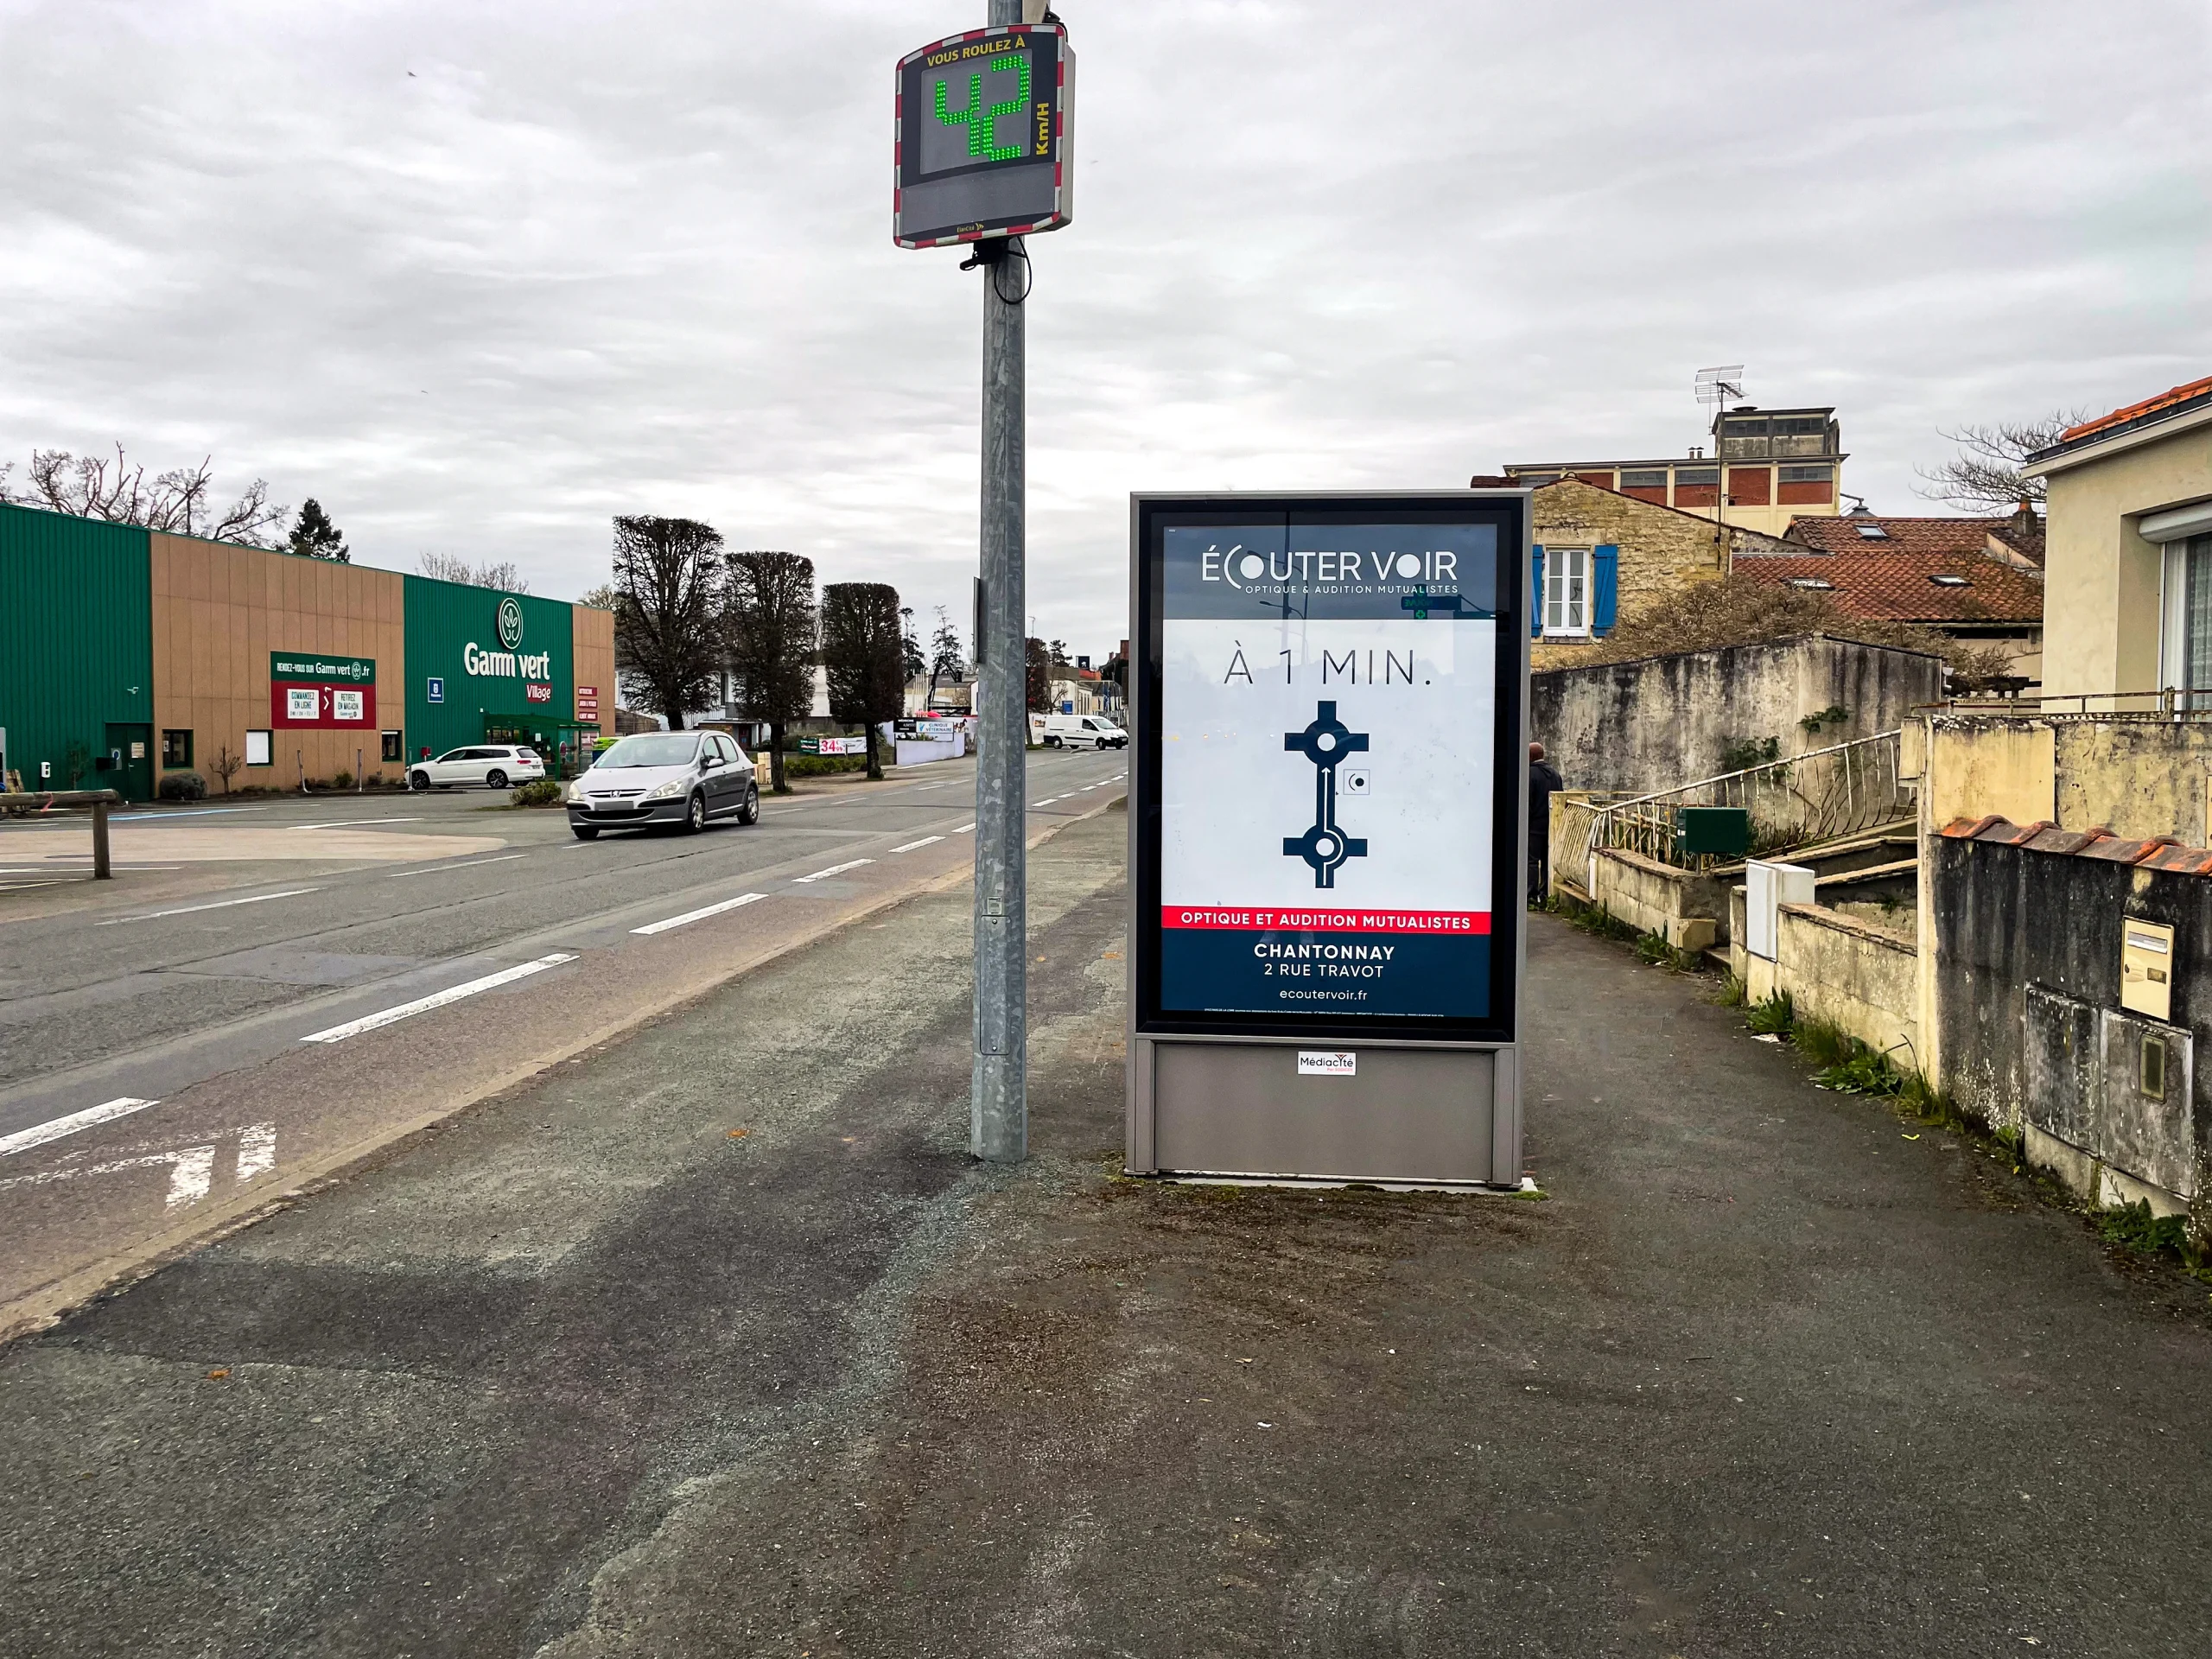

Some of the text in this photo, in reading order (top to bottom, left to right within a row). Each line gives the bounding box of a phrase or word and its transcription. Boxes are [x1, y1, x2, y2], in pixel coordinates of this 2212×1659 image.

[927, 35, 1026, 67] VOUS ROULEZ À
[936, 54, 1030, 162] 42
[1036, 102, 1049, 156] Km/H
[1371, 551, 1458, 582] VOIR
[1245, 585, 1458, 594] OPTIQUE & AUDITION MUTUALISTES
[315, 662, 336, 674] Gamm
[337, 664, 351, 676] vert
[464, 642, 550, 680] Gamm vert
[1224, 640, 1431, 685] À 1 MIN.
[526, 684, 551, 701] Village
[1180, 912, 1471, 929] OPTIQUE ET AUDITION MUTUALISTES
[1254, 944, 1395, 961] CHANTONNAY
[1264, 963, 1384, 978] 2 RUE TRAVOT
[1280, 989, 1368, 1001] ecoutervoir.fr
